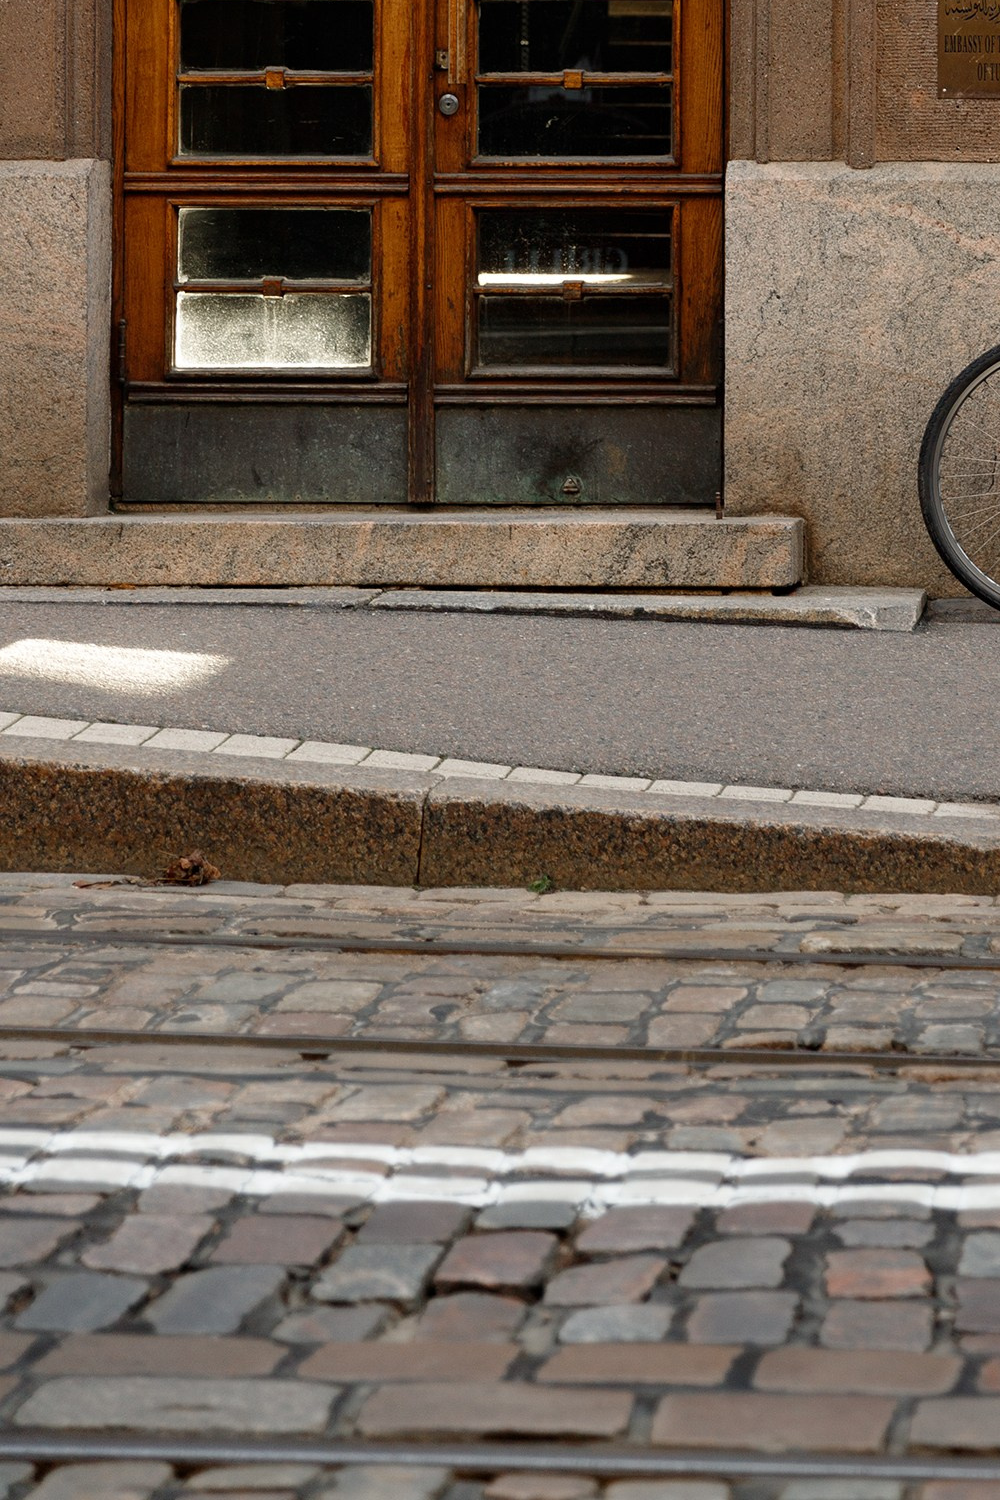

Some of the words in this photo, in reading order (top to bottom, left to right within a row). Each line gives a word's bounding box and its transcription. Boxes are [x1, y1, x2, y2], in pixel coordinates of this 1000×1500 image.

[944, 35, 983, 53] EMBASSY
[985, 35, 996, 53] OF
[977, 62, 988, 81] OF
